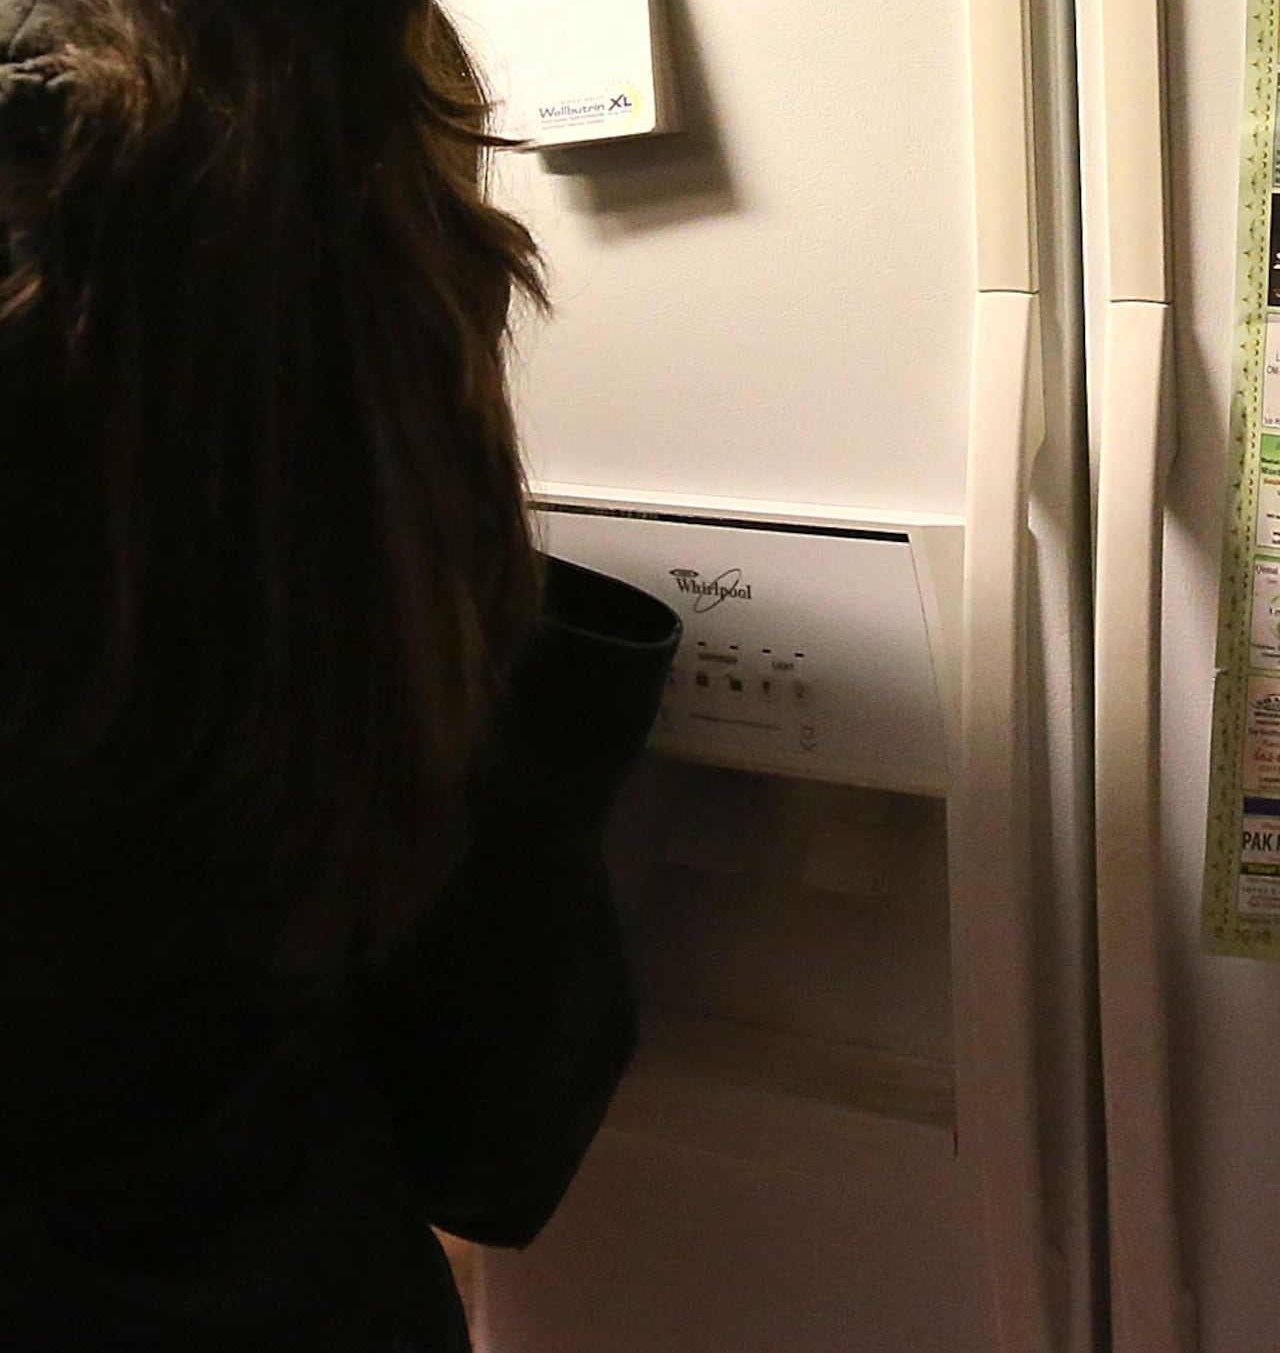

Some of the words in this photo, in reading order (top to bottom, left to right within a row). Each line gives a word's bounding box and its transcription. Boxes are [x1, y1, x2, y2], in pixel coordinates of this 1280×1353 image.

[608, 93, 633, 112] XL
[676, 577, 752, 601] Whirlpool
[1242, 831, 1274, 851] PAK
